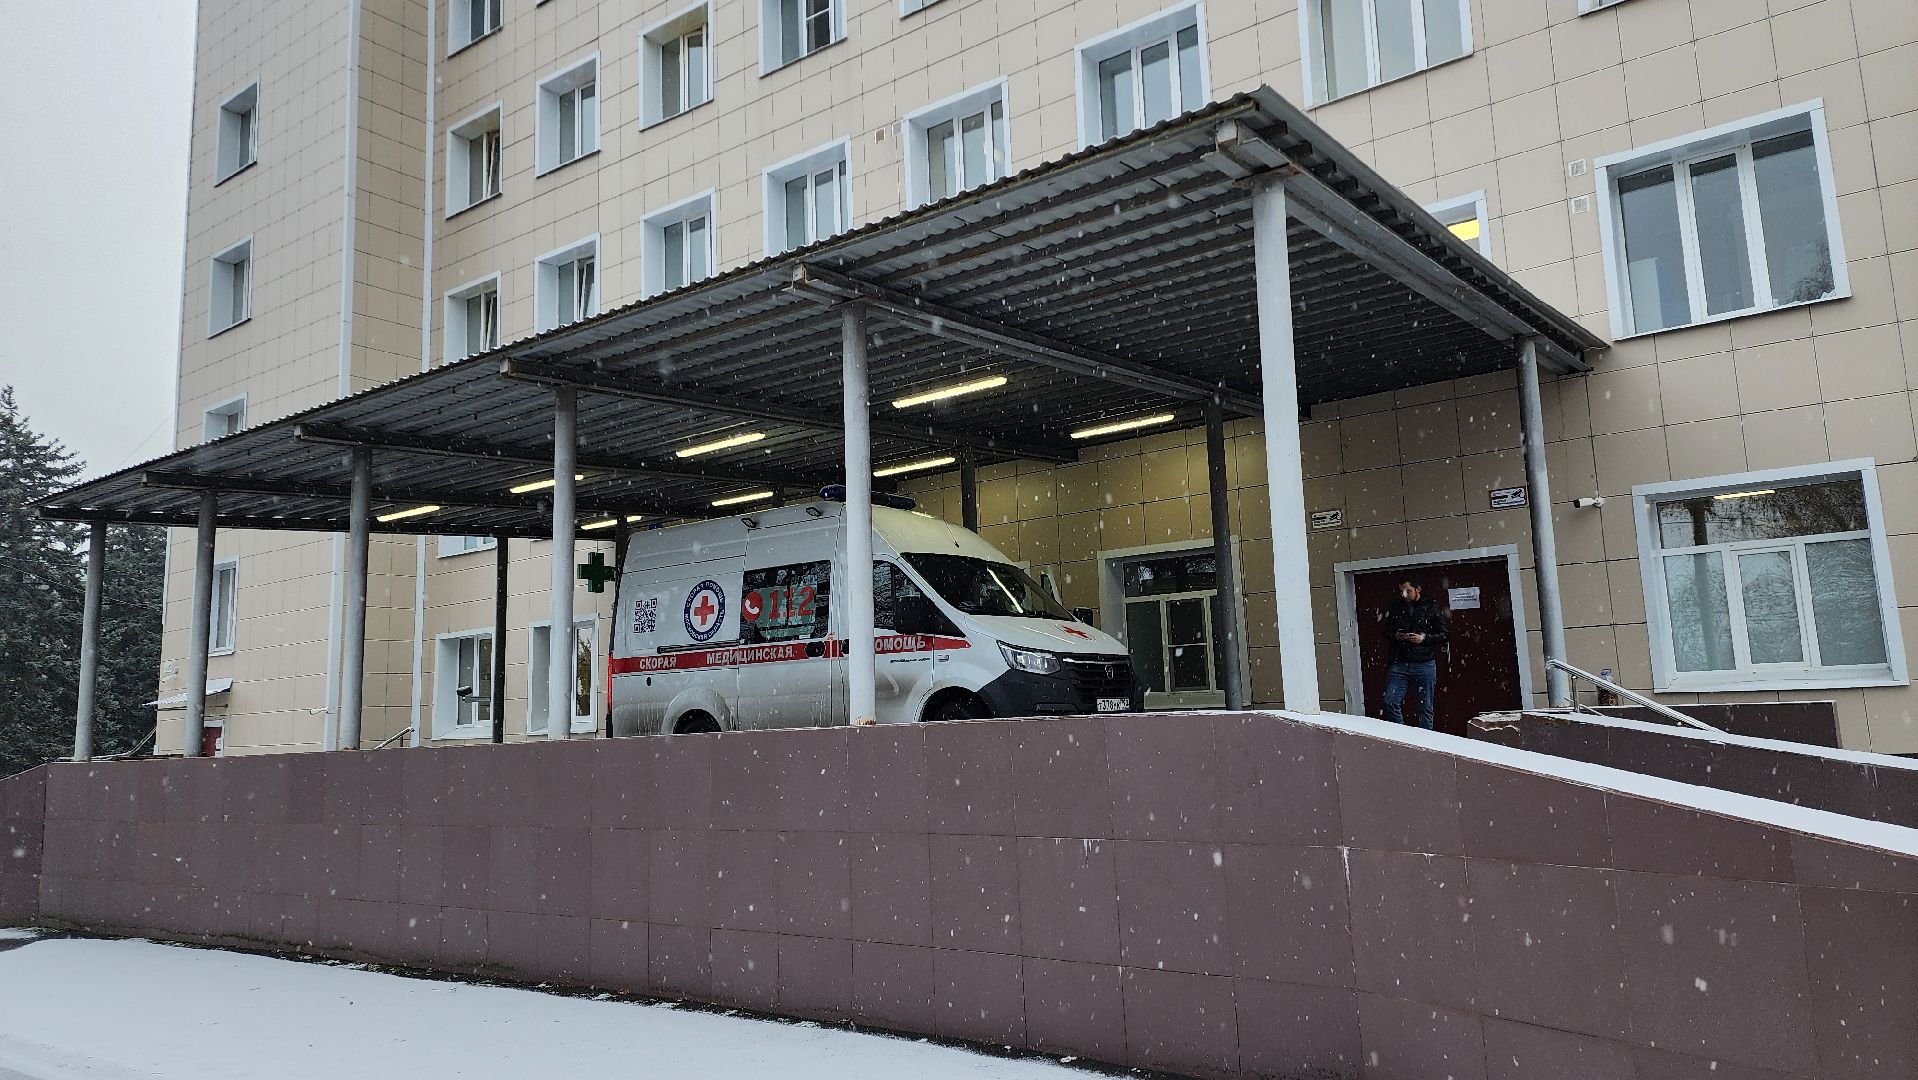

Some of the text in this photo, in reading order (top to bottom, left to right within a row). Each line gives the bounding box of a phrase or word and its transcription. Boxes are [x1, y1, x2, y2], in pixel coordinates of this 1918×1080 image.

[768, 586, 815, 618] 112
[639, 635, 926, 670] СКОРАЯ МЕДИЦИНСКАЯ ОМОЩЬ
